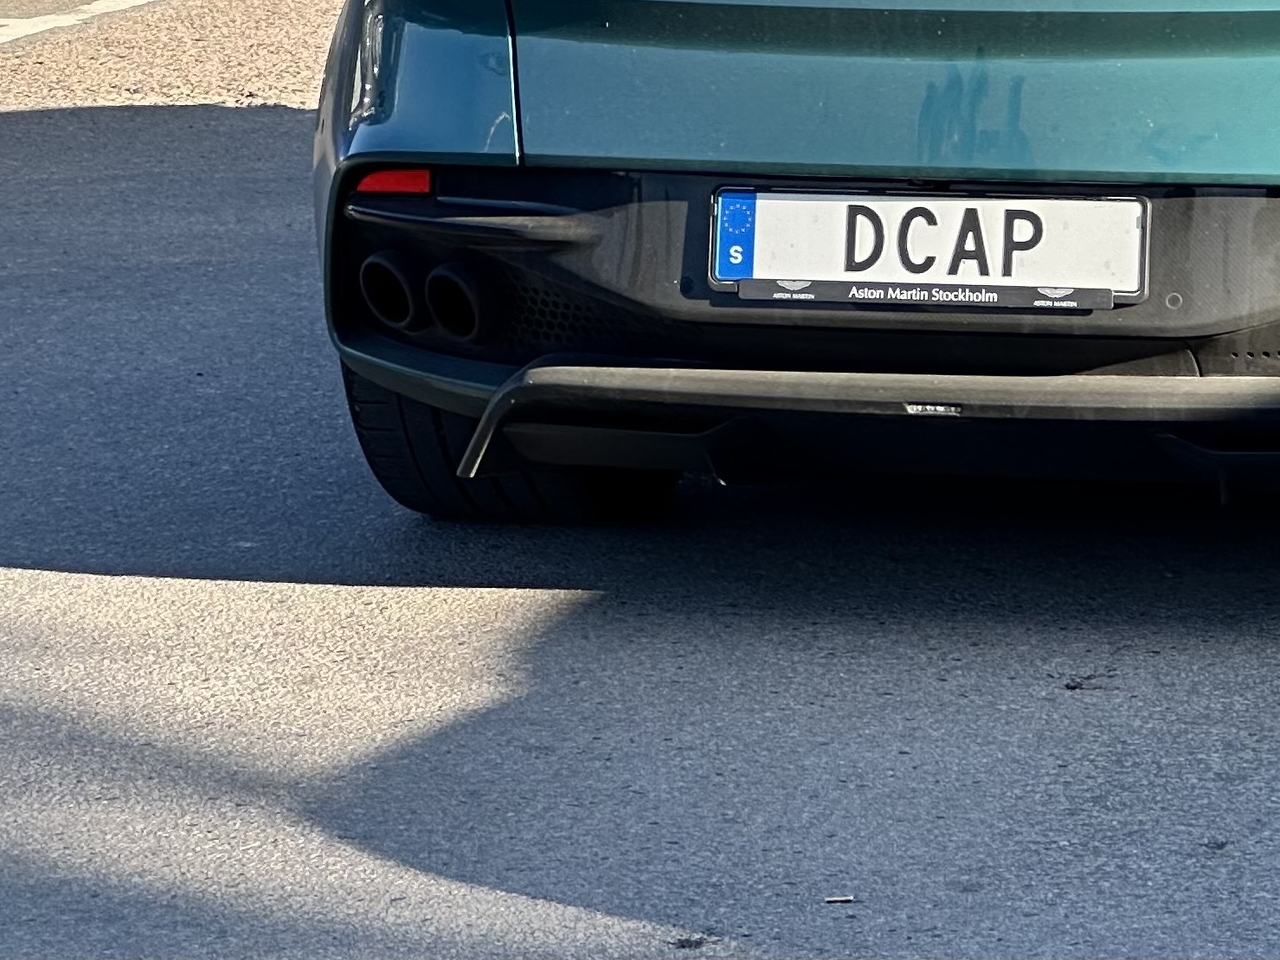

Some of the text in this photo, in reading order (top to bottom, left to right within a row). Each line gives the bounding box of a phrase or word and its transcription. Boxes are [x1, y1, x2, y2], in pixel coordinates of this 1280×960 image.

[843, 204, 1044, 277] DCAP
[729, 245, 744, 264] S
[848, 286, 998, 303] Aston Martin Stockholm
